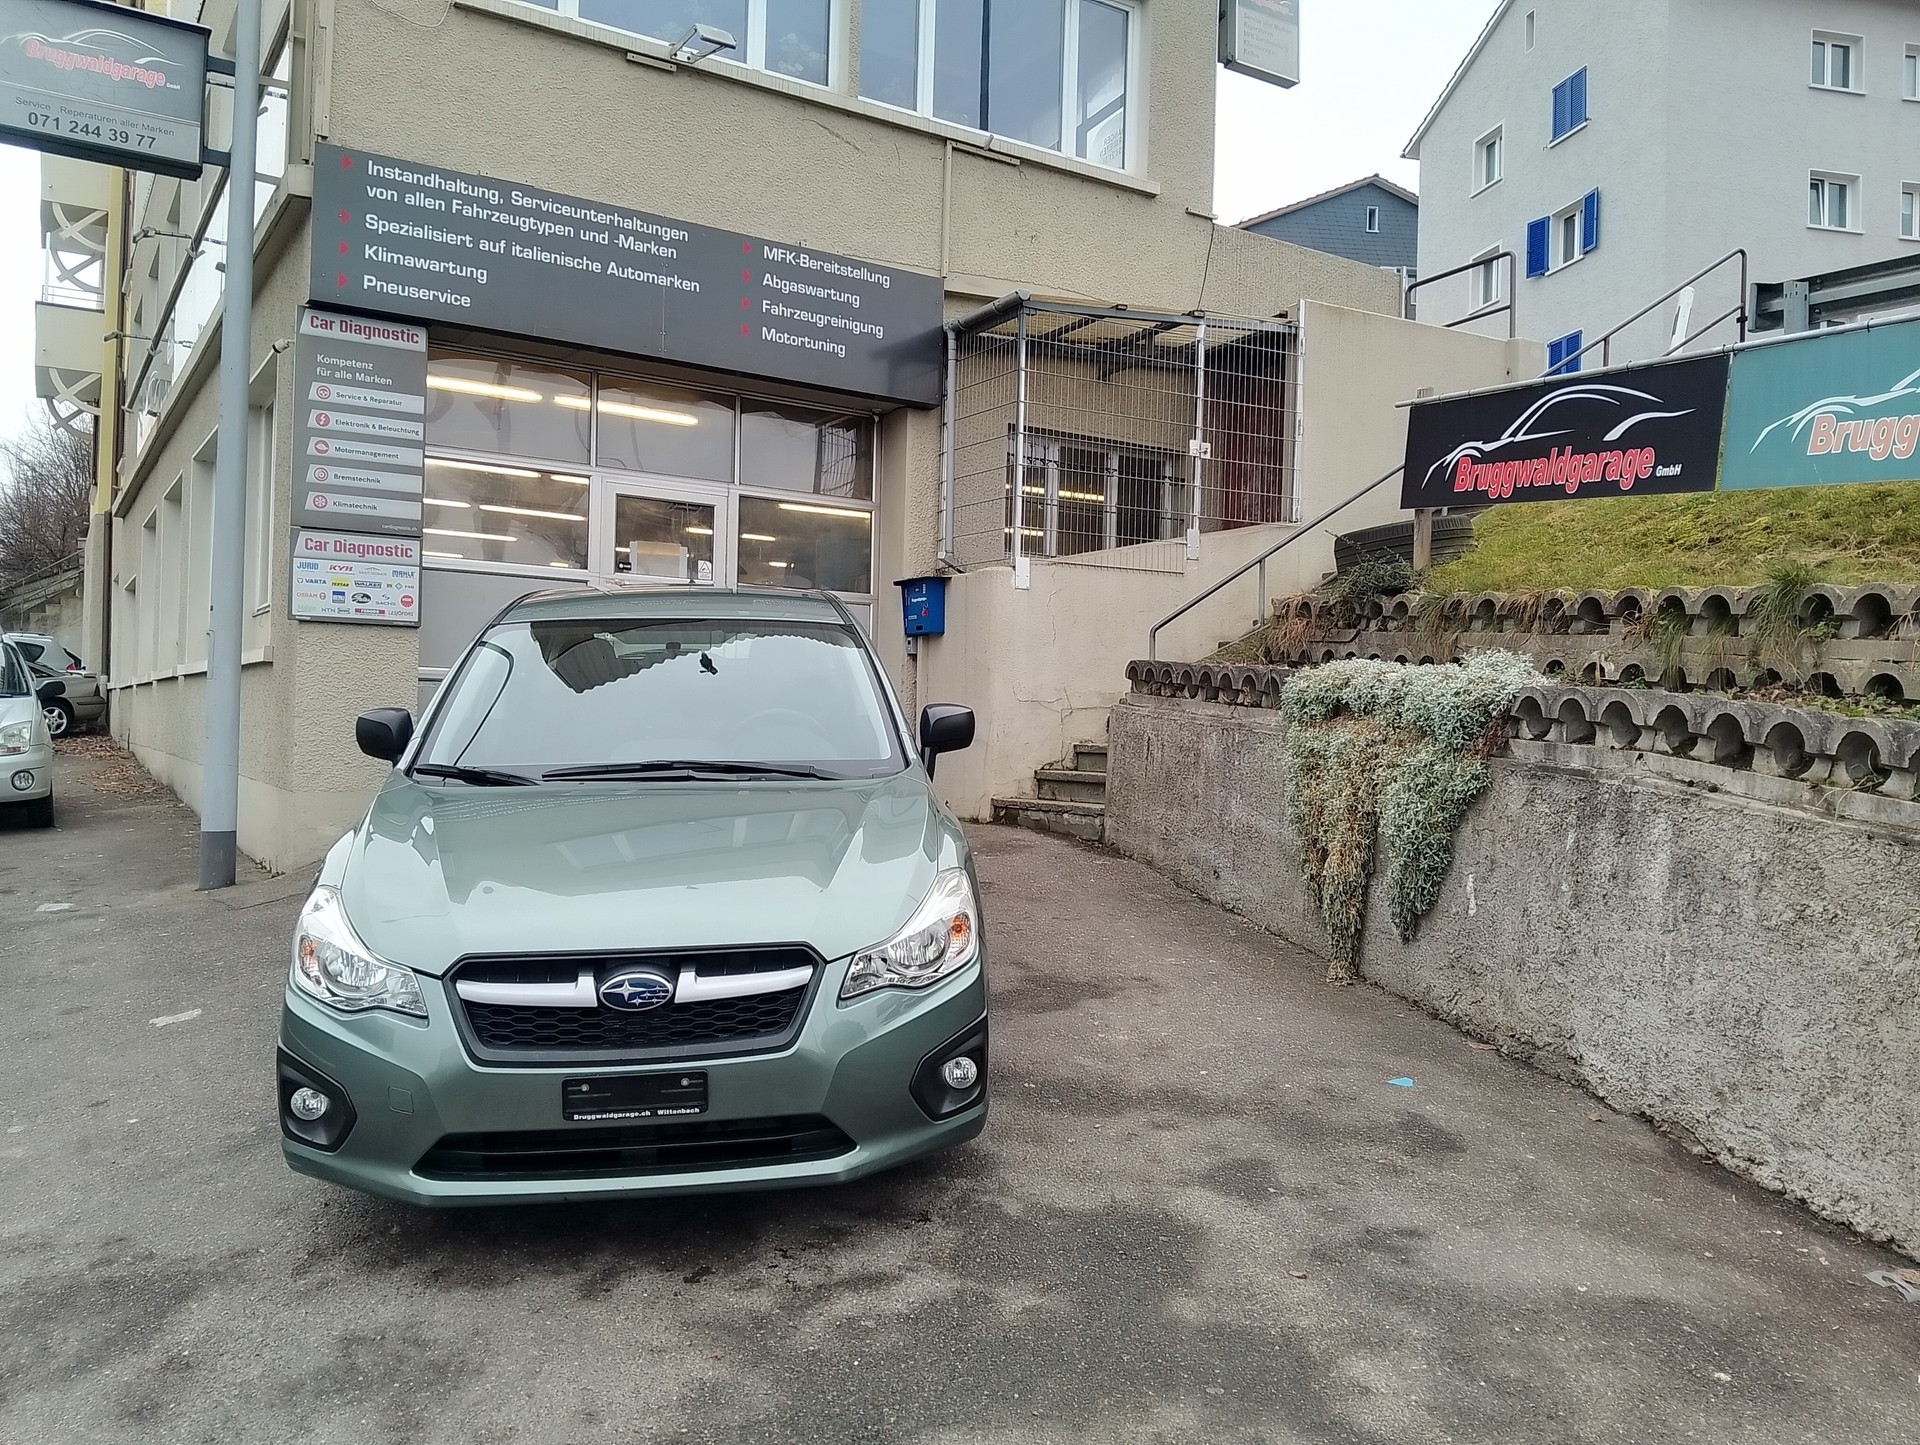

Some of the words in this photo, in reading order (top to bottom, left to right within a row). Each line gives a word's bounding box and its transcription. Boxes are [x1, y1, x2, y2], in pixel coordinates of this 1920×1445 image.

[25, 38, 166, 89] Bruggwaldgarage
[15, 97, 51, 111] Service
[120, 118, 139, 129] aller
[142, 122, 175, 137] Marken
[28, 112, 60, 130] 071
[68, 120, 102, 138] 244
[108, 127, 129, 144] 39
[136, 133, 157, 149] 77
[367, 160, 505, 204] Instandhaltung,
[510, 191, 689, 242] Serviceunterhaltungen
[366, 185, 398, 202] von
[404, 191, 445, 212] allen
[451, 200, 574, 238] Fahrzeugtypen
[579, 227, 609, 245] und
[613, 234, 677, 259] -Marken
[364, 244, 488, 284] Klimawartung
[365, 213, 473, 248] Spezialisiert
[479, 239, 506, 255] auf
[511, 241, 602, 273] italienische
[606, 262, 700, 293] Automarken
[763, 246, 890, 288] MFK-Bereitstellung
[363, 275, 471, 308] Pneuservice
[762, 273, 860, 308] Abgaswartung
[310, 315, 335, 331] Car
[339, 320, 419, 344] Diagnostic
[762, 300, 884, 339] Fahrzeugreinigung
[761, 327, 846, 358] Motortuning
[316, 367, 331, 377] für
[334, 370, 352, 380] alle
[355, 372, 393, 386] Marken
[317, 354, 373, 370] Kompetenz
[336, 391, 362, 401] Service
[369, 394, 403, 407] Reparatur
[335, 418, 370, 429] Elektronik
[378, 424, 420, 436] Beleuchtung
[334, 446, 399, 460] Motormanagement
[333, 473, 381, 484] Bremstechnik
[1453, 445, 1655, 499] Bruggwaldgarage
[1656, 463, 1682, 477] GmbH
[332, 500, 378, 511] Klimatechnik
[304, 537, 329, 552] Car
[333, 539, 413, 558] Diagnostic
[297, 562, 319, 570] JURID
[573, 1110, 651, 1121] Bruggwaldgarage.ch
[657, 1107, 700, 1116] Wittenbach
